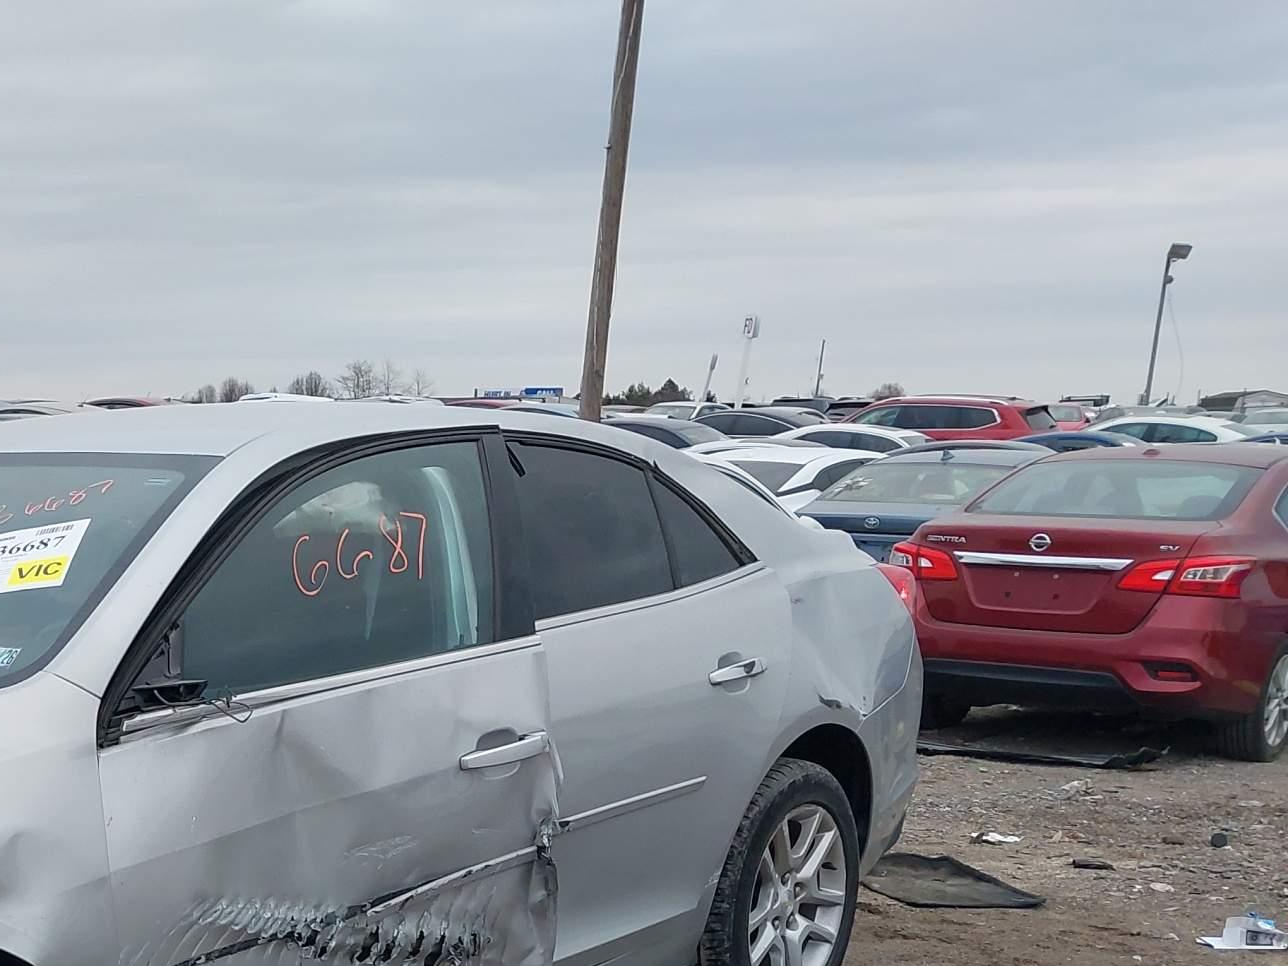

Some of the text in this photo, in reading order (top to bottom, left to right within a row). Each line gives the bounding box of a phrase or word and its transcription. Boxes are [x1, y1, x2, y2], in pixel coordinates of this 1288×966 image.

[926, 534, 967, 543] SENTRA
[292, 511, 427, 596] 6687
[16, 561, 62, 580] VIC
